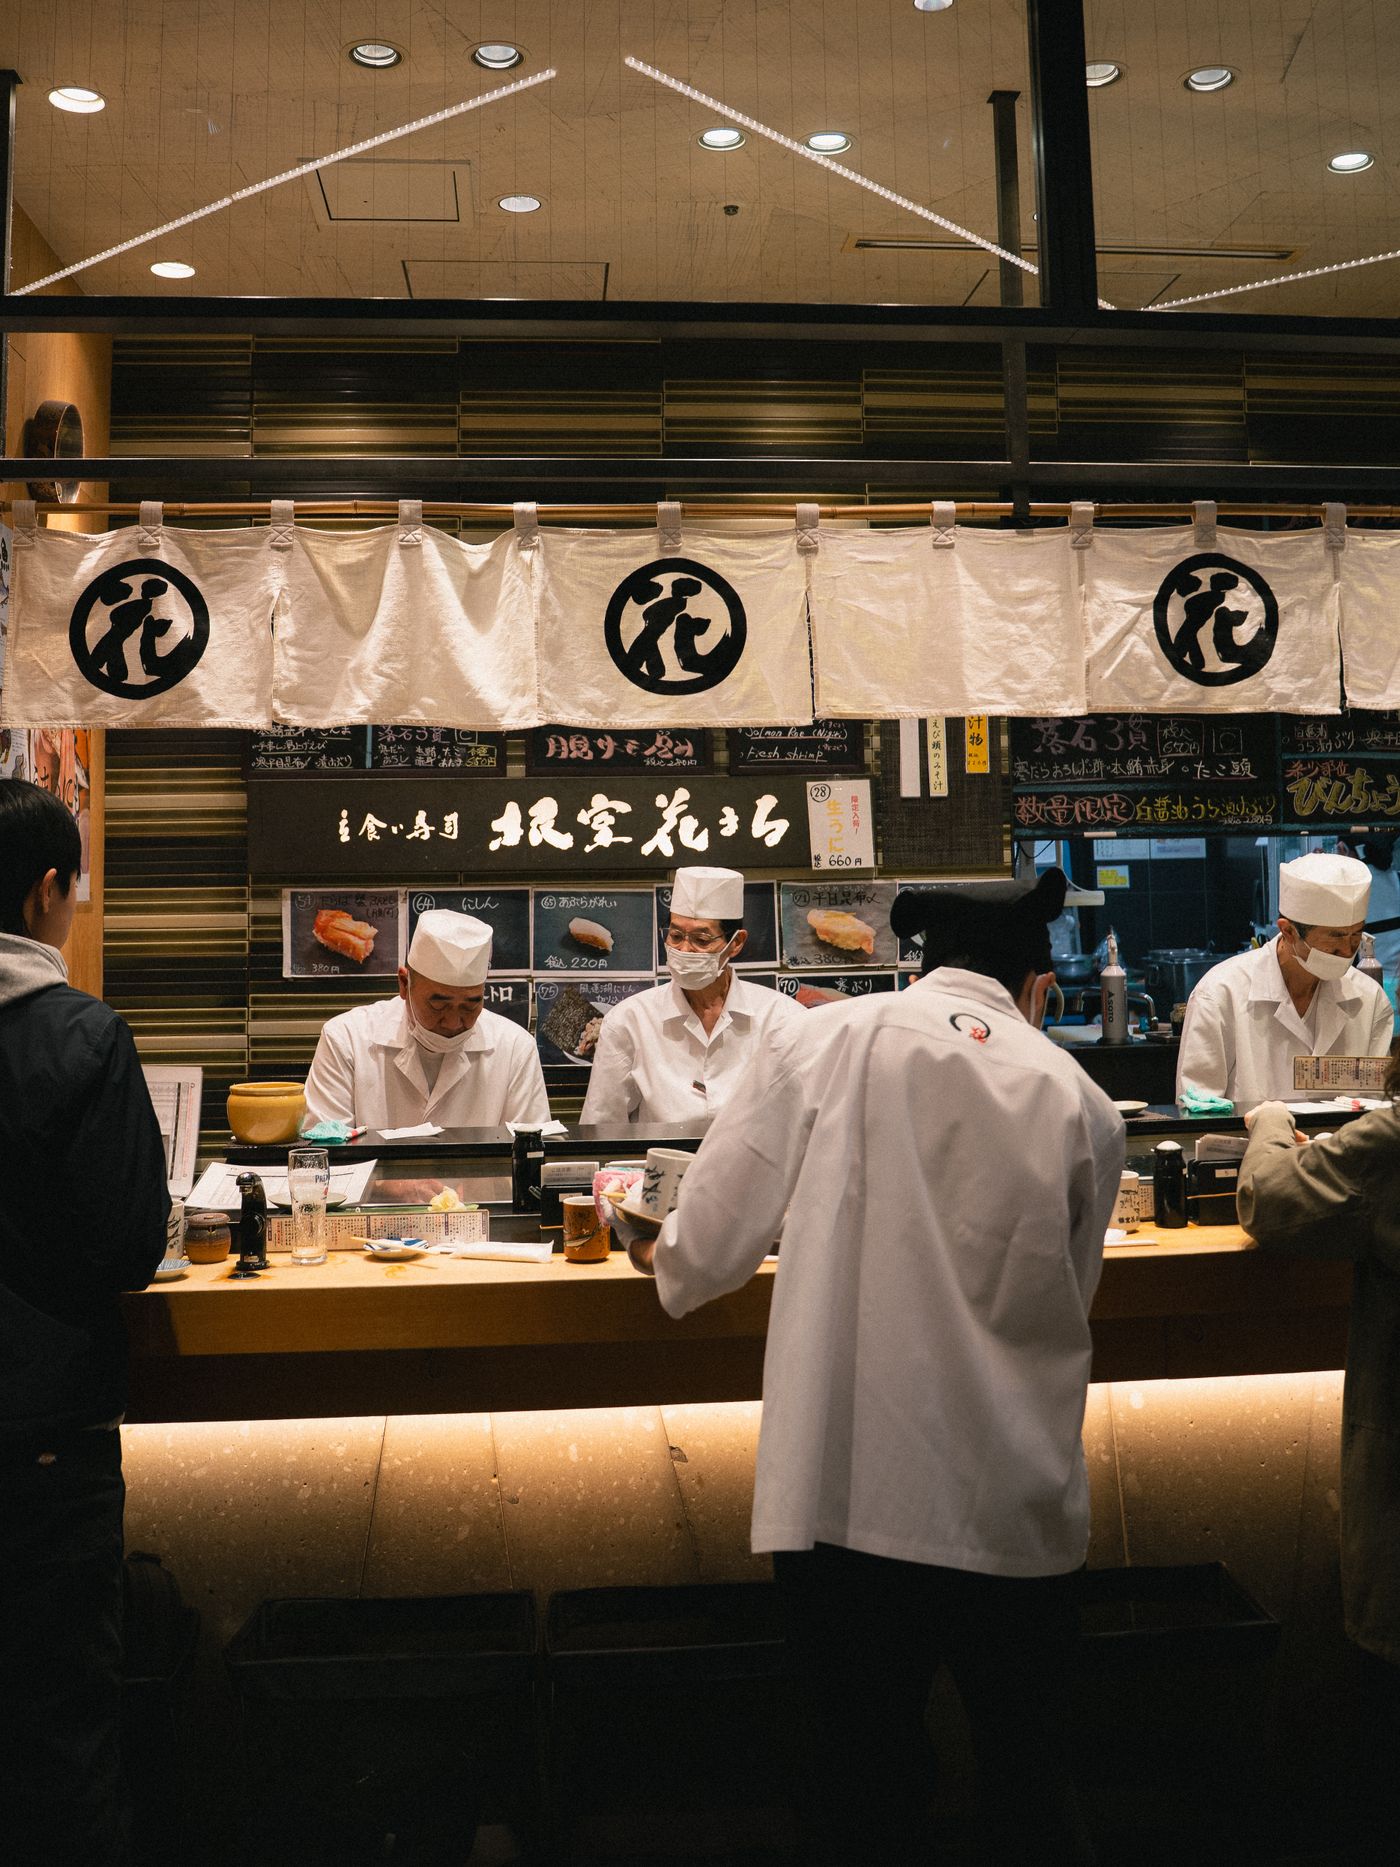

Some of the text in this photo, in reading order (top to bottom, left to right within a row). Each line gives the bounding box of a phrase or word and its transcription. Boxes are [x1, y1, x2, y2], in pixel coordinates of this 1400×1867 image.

[967, 714, 984, 747] 汁物
[1015, 792, 1132, 825] 数量限定
[826, 799, 845, 853] 生うに
[462, 896, 499, 911] にしん
[570, 956, 608, 969] 220円
[540, 985, 556, 999] 75
[780, 980, 797, 995] 70
